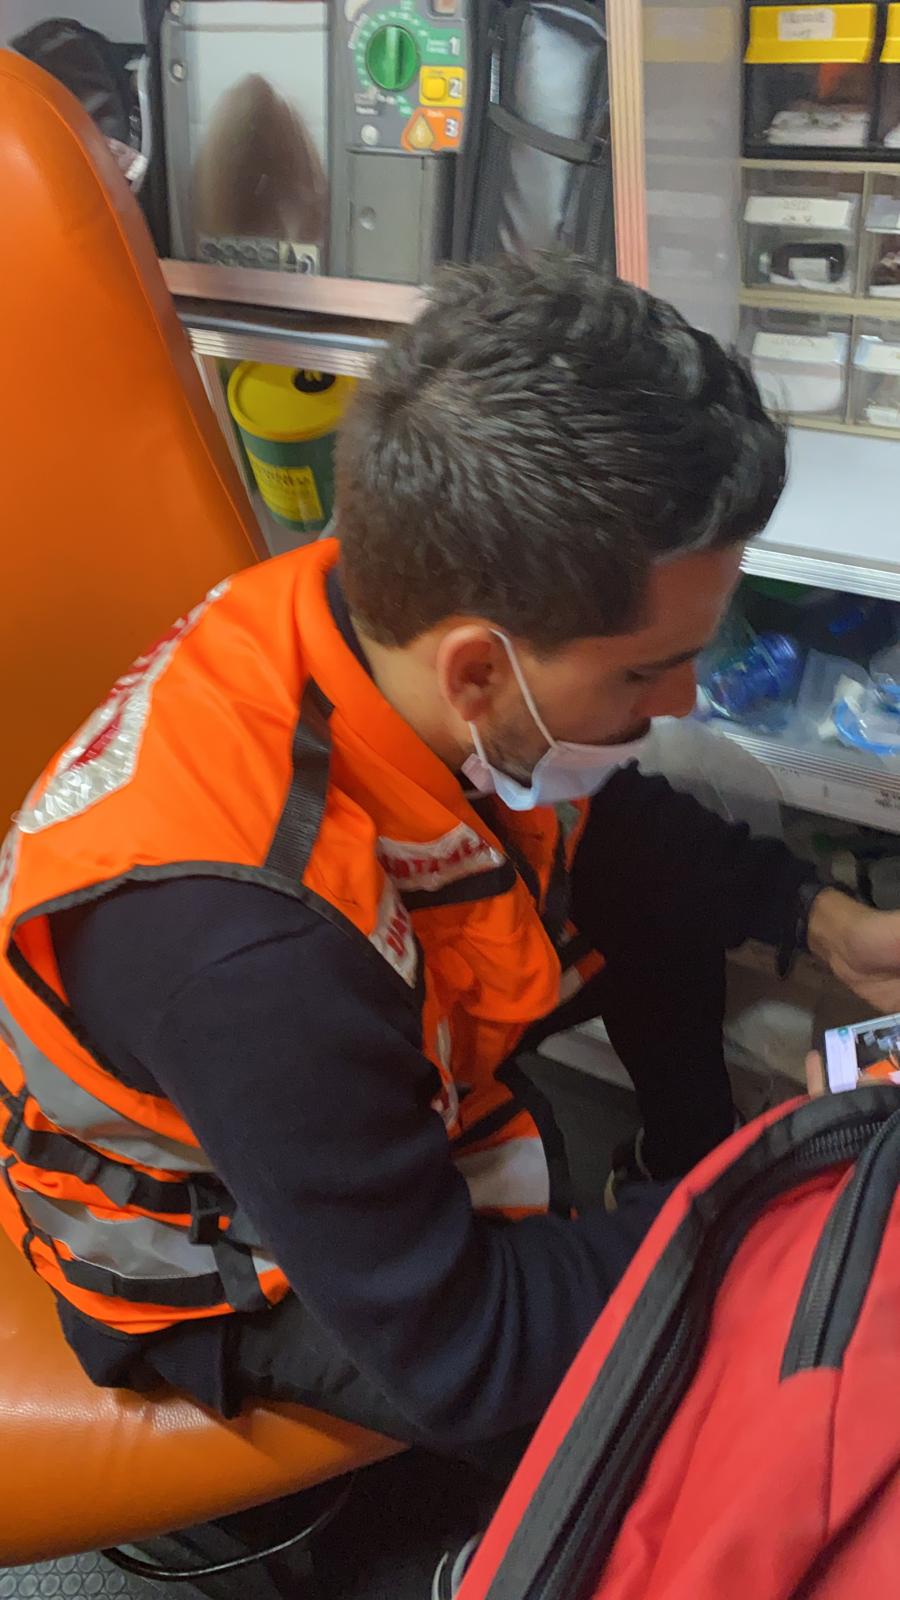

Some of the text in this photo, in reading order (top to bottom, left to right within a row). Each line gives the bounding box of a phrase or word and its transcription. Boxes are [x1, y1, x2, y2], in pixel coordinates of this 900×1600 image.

[449, 36, 461, 55] 1
[448, 78, 463, 98] 2
[445, 118, 459, 137] 3
